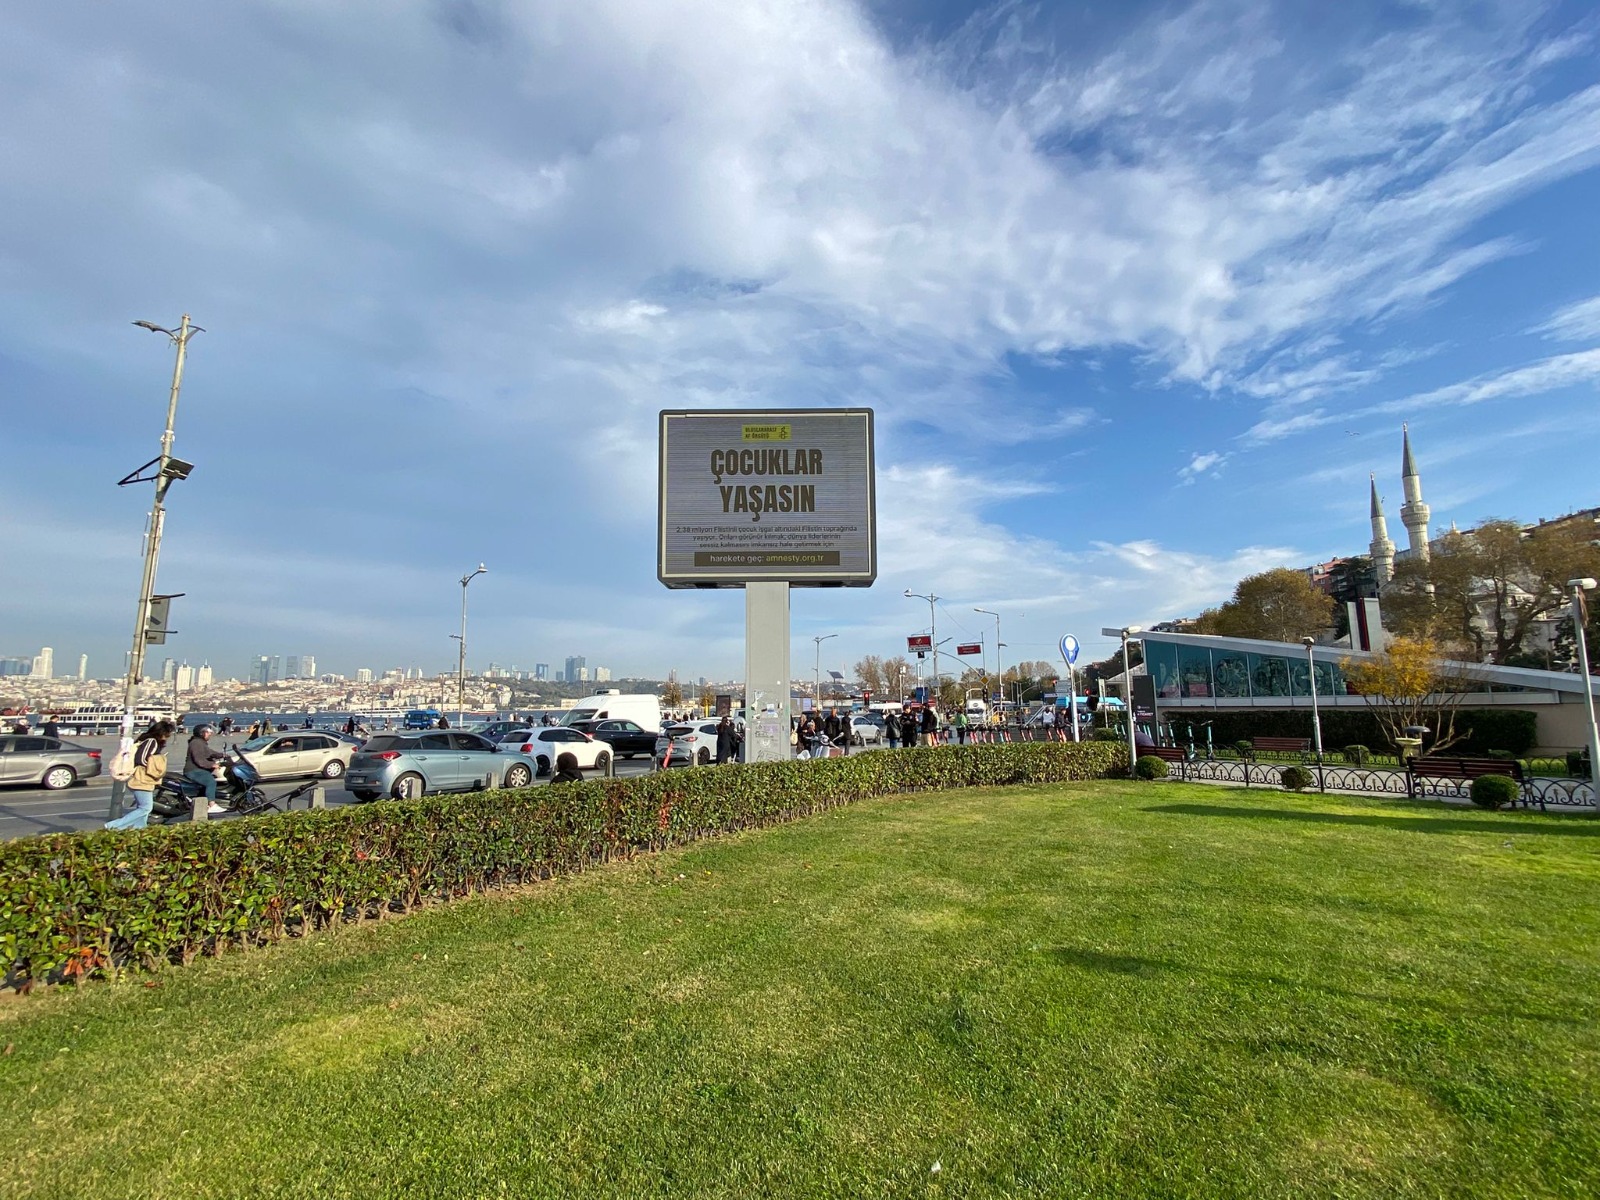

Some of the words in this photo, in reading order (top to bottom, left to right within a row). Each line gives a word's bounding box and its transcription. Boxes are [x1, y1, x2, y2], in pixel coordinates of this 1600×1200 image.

[711, 449, 822, 484] ÇOCUKLAR
[720, 485, 814, 522] YAŞASIN
[739, 526, 756, 534] çocuk
[766, 554, 824, 563] amnesty.org.tr
